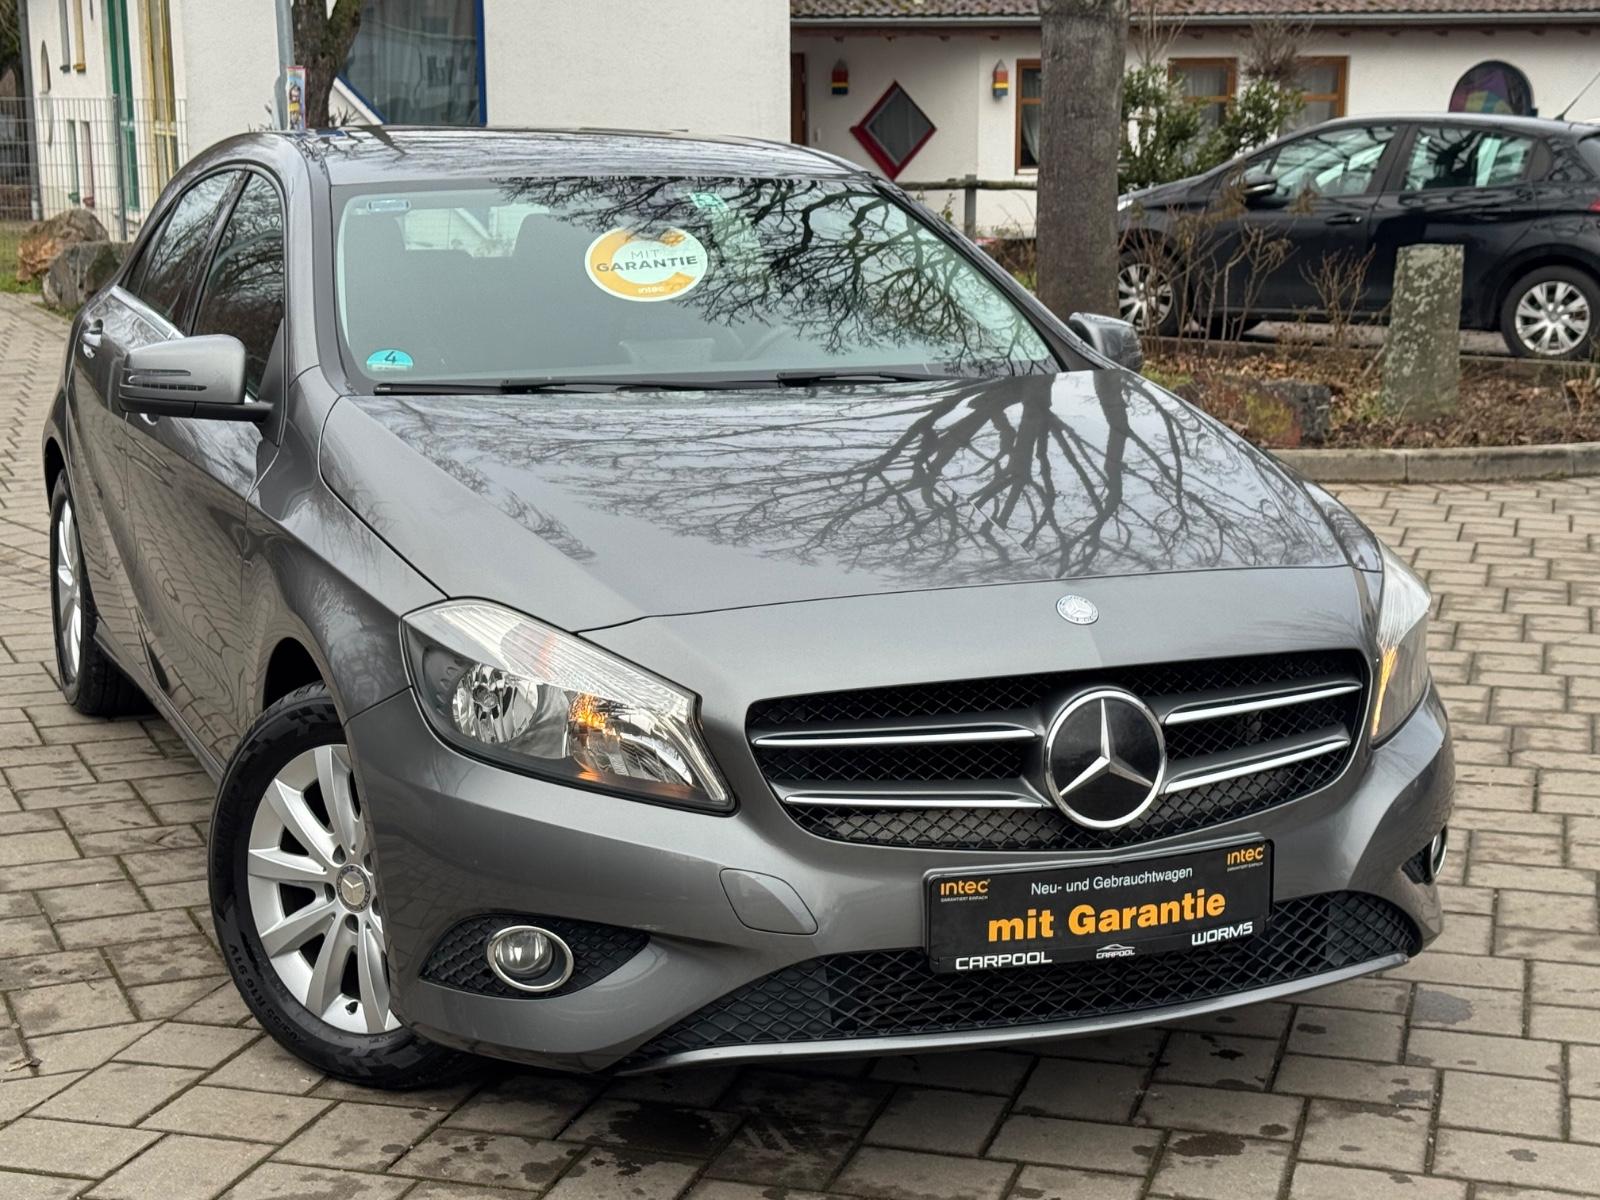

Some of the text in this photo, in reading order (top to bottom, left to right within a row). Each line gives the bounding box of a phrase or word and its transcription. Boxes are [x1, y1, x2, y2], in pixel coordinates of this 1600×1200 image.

[631, 250, 660, 259] MIT
[597, 256, 697, 271] GARANTIE
[385, 350, 397, 363] 4
[1227, 847, 1264, 865] intec
[940, 880, 989, 896] intec
[1031, 866, 1193, 895] Neu- und Gebrauchtwagen
[988, 889, 1226, 942] mit Garantie
[1191, 922, 1253, 945] WORMS
[955, 951, 1052, 970] CARPOOL
[1096, 949, 1135, 959] CARPOOL
